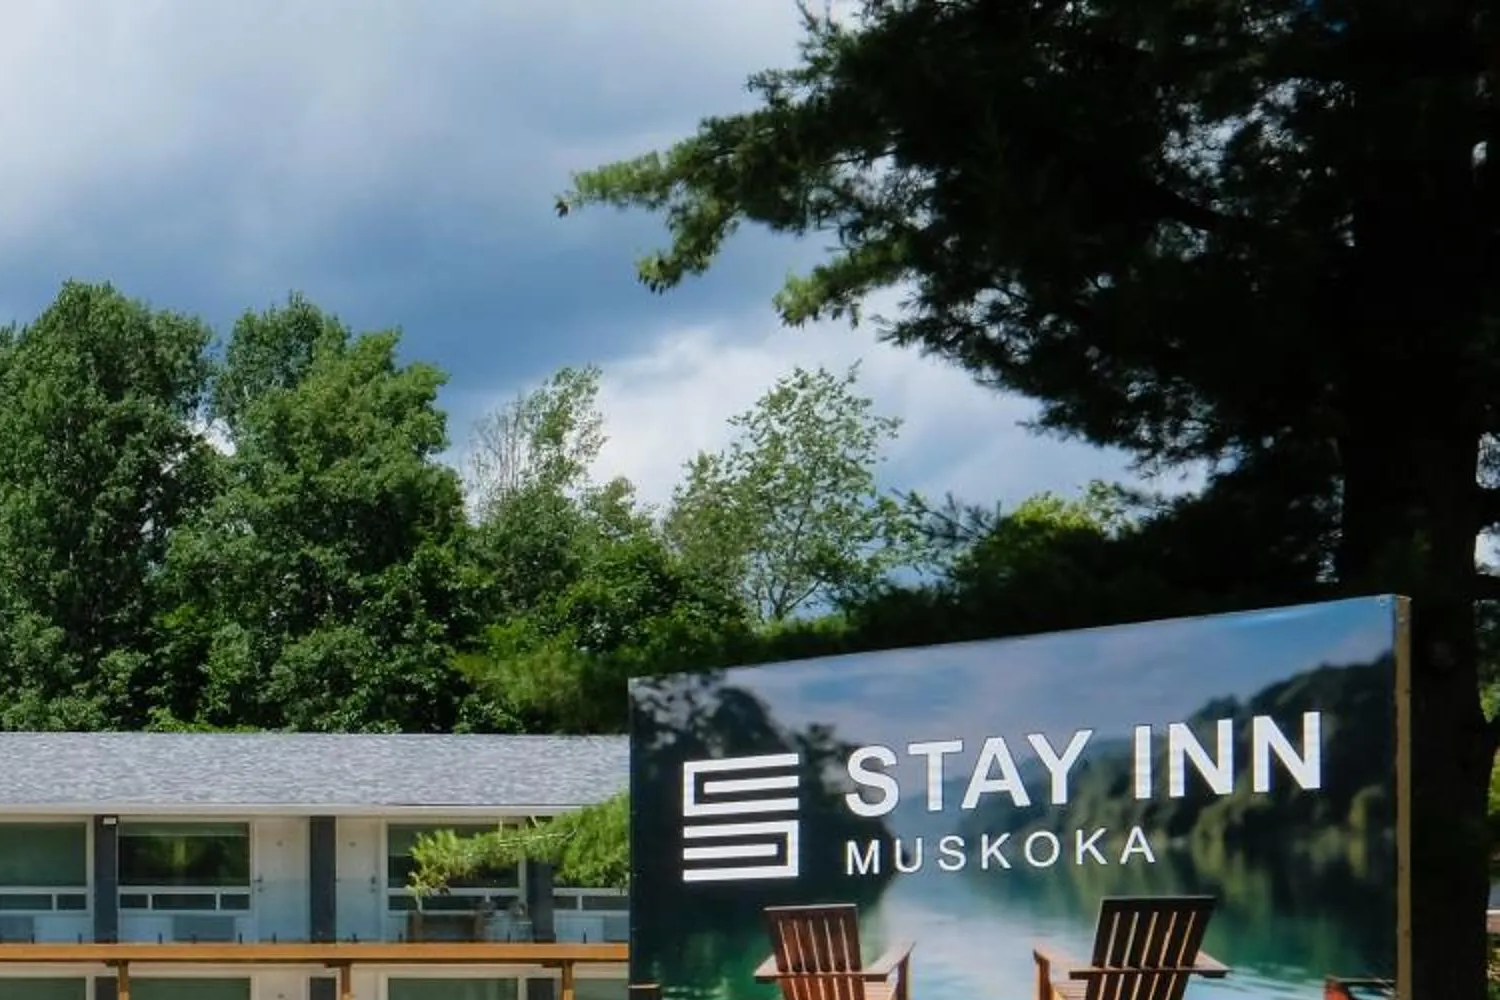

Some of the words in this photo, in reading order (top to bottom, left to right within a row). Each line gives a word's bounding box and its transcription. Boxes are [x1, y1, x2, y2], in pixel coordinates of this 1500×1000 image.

[845, 729, 1094, 817] STAY
[1134, 711, 1321, 799] INN
[846, 825, 1156, 875] MUSKOKA
